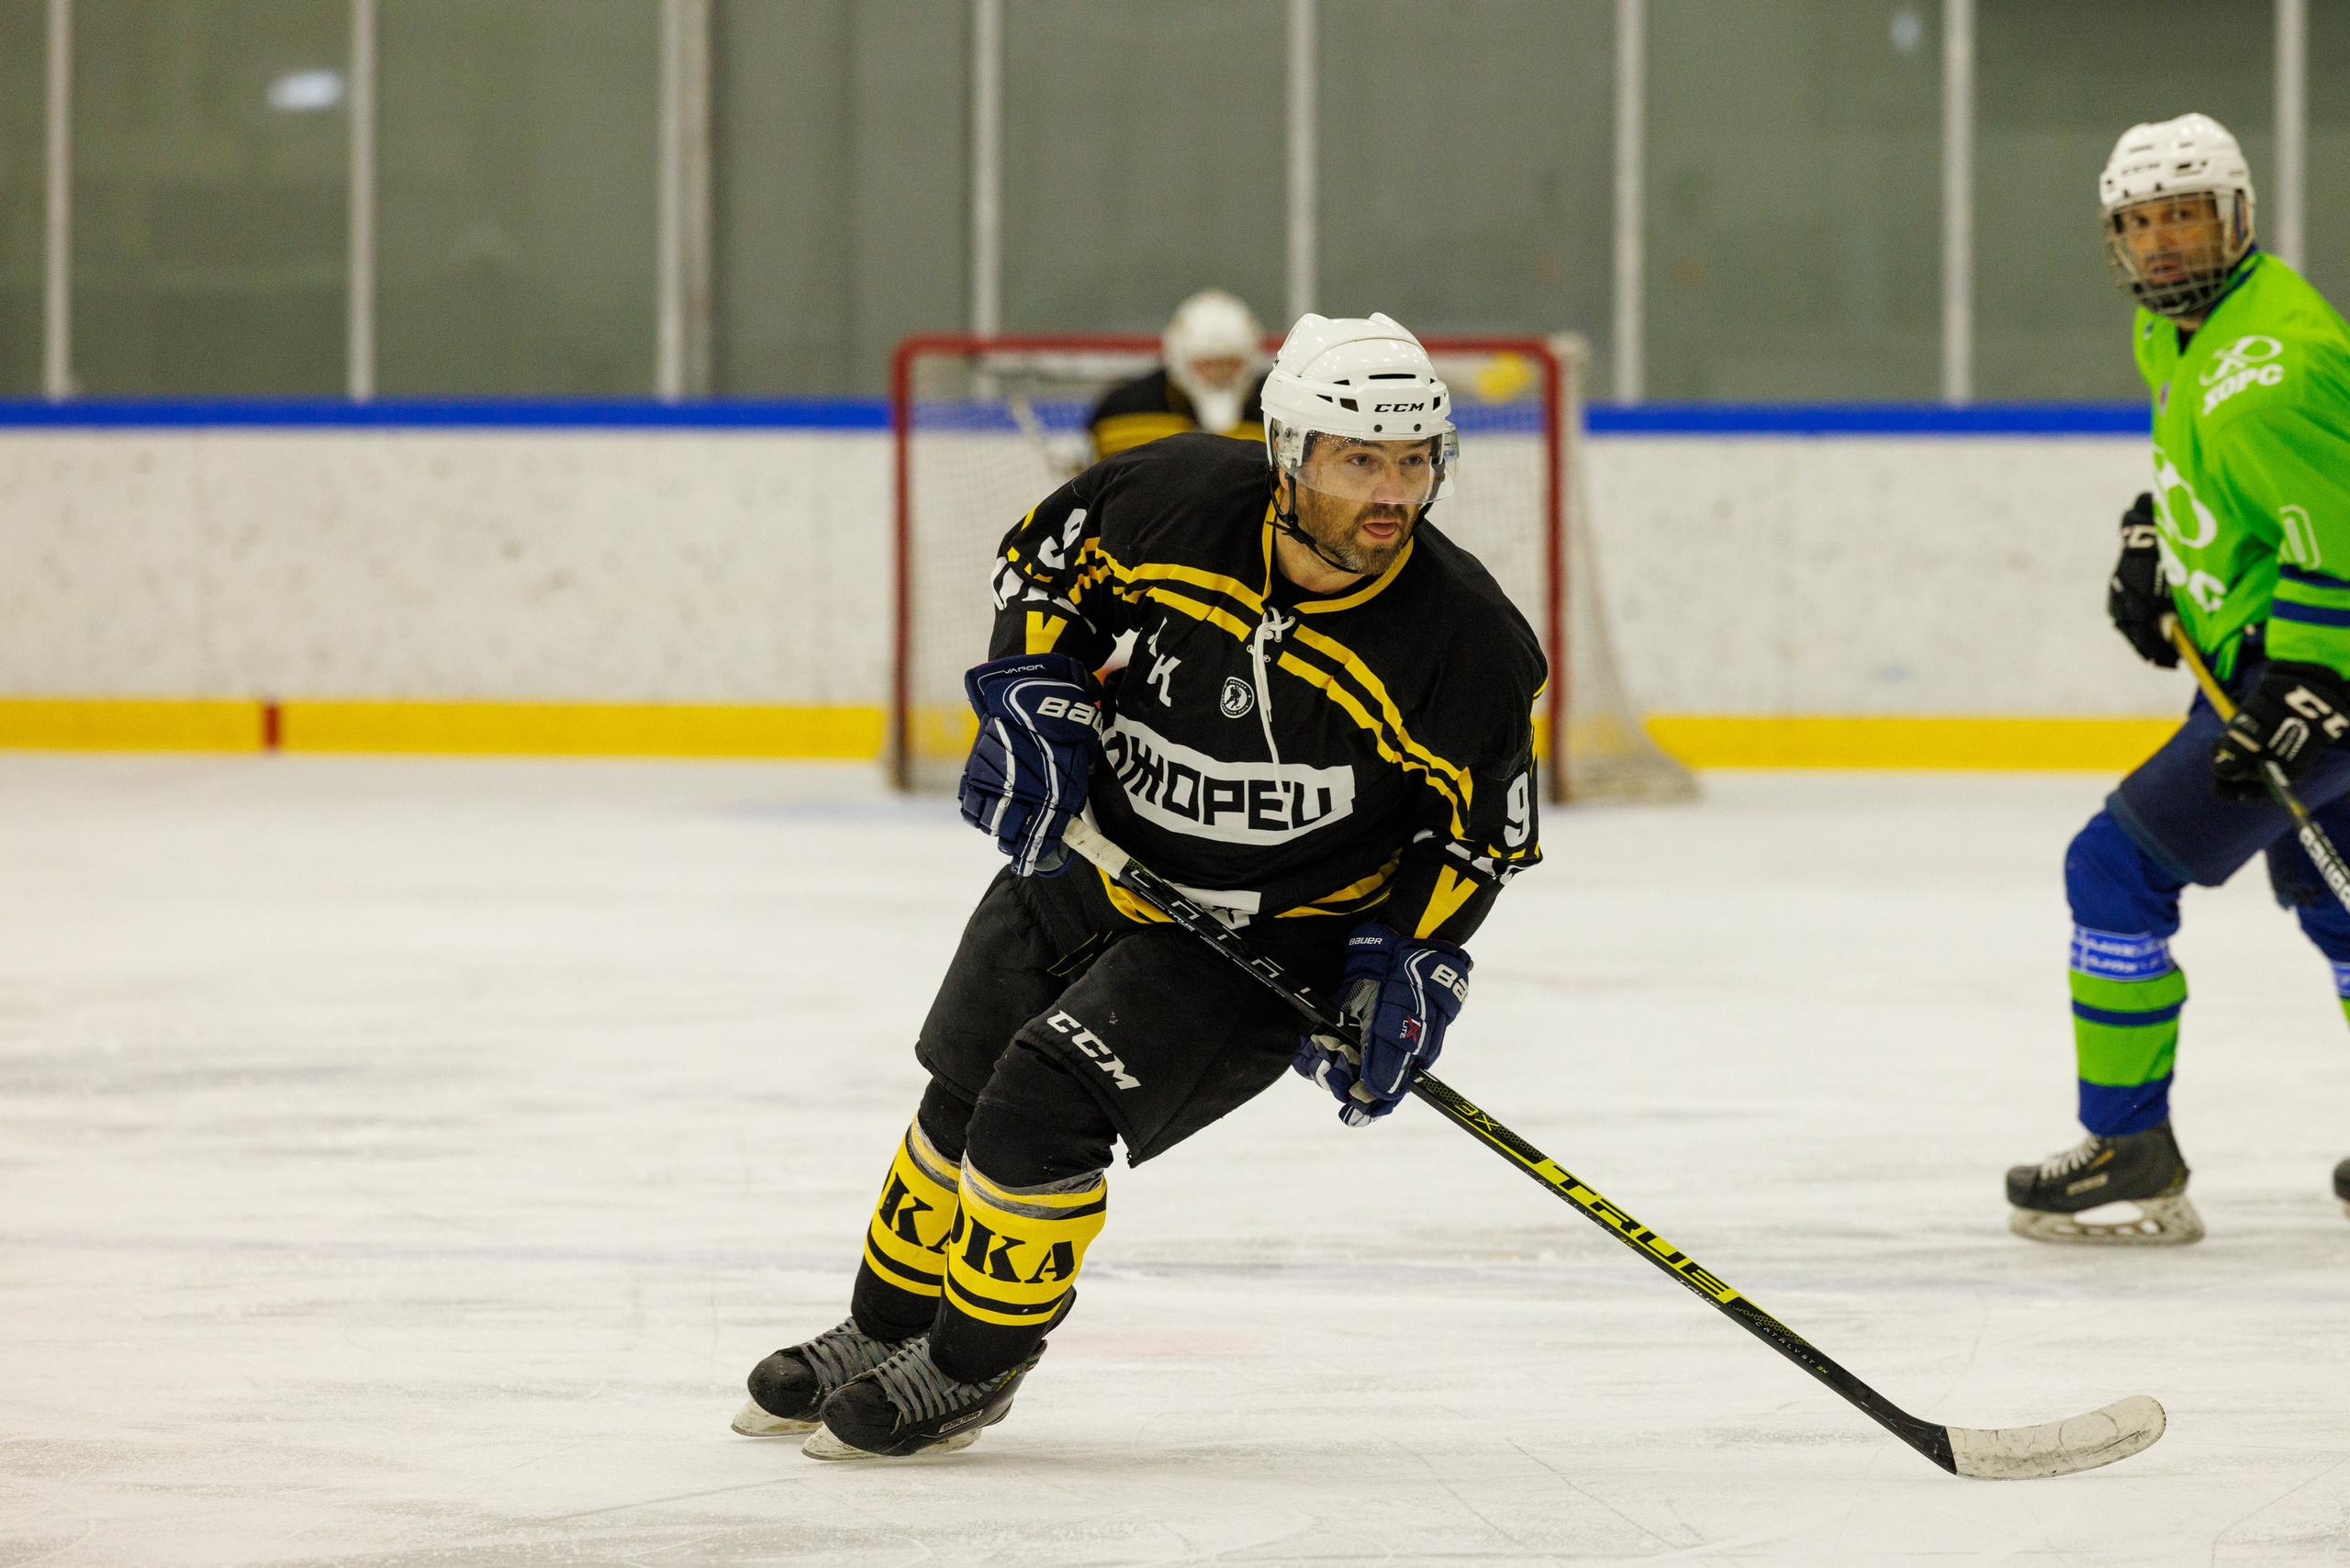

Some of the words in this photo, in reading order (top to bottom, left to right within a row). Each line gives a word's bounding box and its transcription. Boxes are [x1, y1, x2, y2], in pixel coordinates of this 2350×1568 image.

[1374, 402, 1425, 413] CCM
[1002, 664, 1046, 675] VAPOR
[1503, 771, 1531, 848] 9
[1046, 1011, 1142, 1091] CCM
[1552, 1164, 1730, 1296] TRUE
